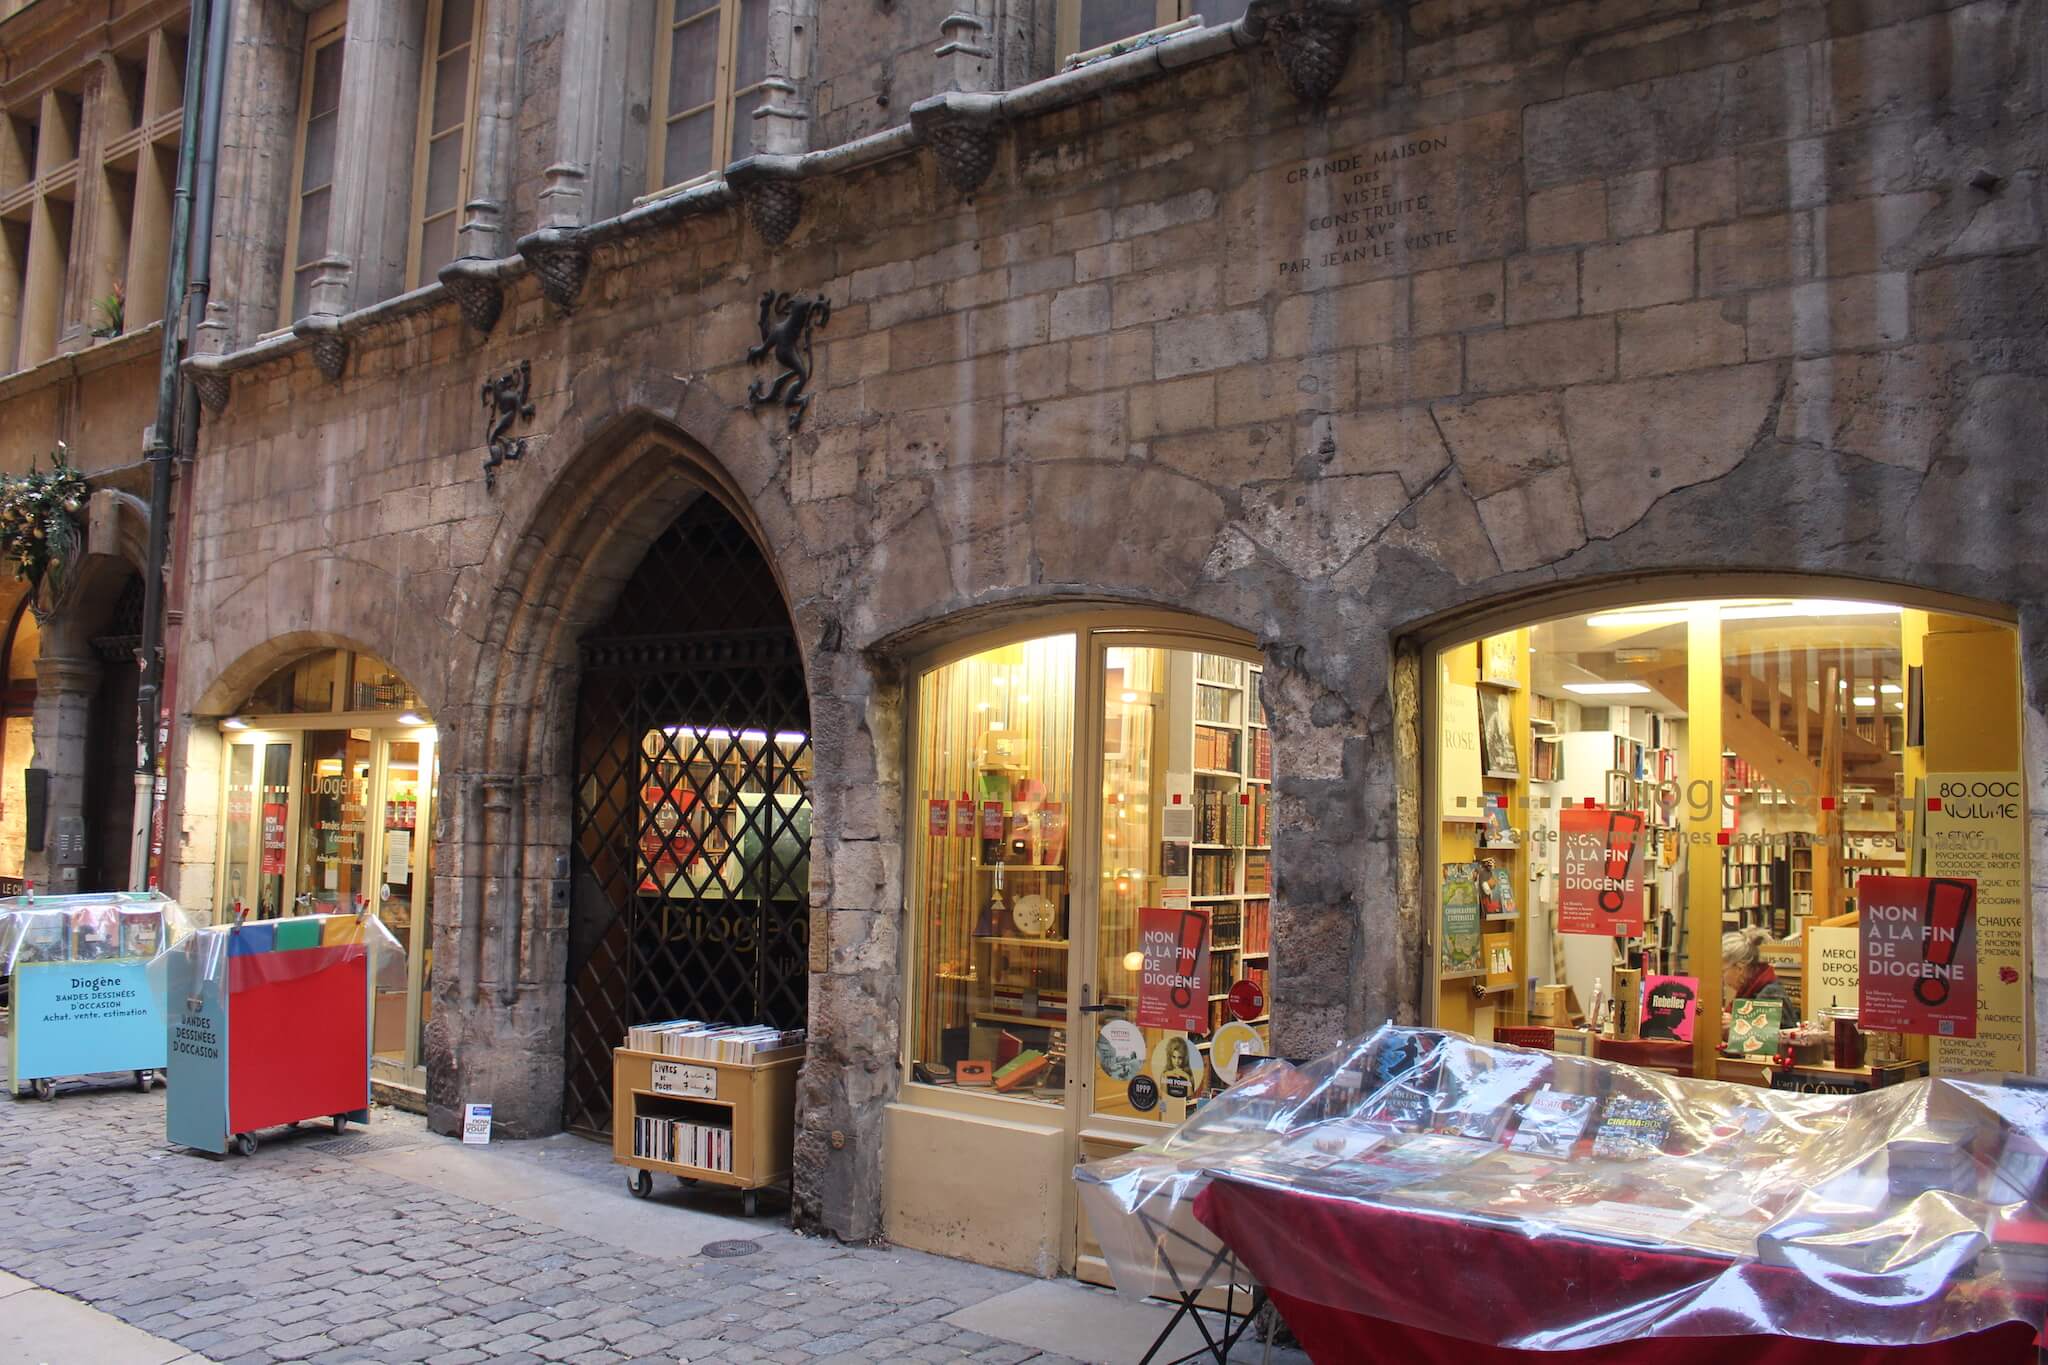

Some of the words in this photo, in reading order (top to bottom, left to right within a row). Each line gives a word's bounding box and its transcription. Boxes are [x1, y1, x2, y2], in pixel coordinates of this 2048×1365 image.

[1287, 155, 1363, 184] GRANDE
[1373, 136, 1449, 165] MAISON
[1353, 171, 1380, 186] DES
[1343, 184, 1392, 206] VISTE
[1309, 195, 1428, 232] CONSTRUITE
[1336, 229, 1358, 247] AU
[1279, 258, 1311, 276] PAR
[1373, 241, 1395, 258] LE
[1403, 230, 1457, 250] VISTE
[1445, 729, 1474, 751] ROSE
[311, 772, 356, 800] Diogè
[1609, 826, 1711, 845] modernes
[1566, 846, 1575, 860] À
[1580, 848, 1599, 861] LA
[1604, 848, 1629, 862] FIN
[1566, 863, 1585, 875] DE
[3, 883, 12, 894] LE
[1566, 876, 1635, 892] DIOGÈNE
[1869, 905, 1918, 921] NON
[1144, 931, 1174, 944] NON
[1868, 920, 1882, 938] À
[1888, 924, 1914, 940] LA
[1921, 926, 1955, 942] FIN
[1156, 947, 1172, 958] LA
[1175, 946, 1197, 961] FIN
[1822, 948, 1856, 959] MERCI
[1869, 941, 1896, 958] DE
[1144, 958, 1160, 972] DE
[1822, 962, 1858, 973] DEPOS
[1869, 959, 1965, 980] DIOGÈNE
[71, 976, 122, 991] Diogène
[1144, 970, 1201, 989] DIOGÈNE
[1822, 976, 1845, 986] VOS
[56, 992, 89, 1002] BANDES
[91, 990, 136, 1000] DESSINÉES
[1652, 994, 1685, 1010] Rebelles
[71, 1001, 121, 1011] D'OCCASION
[103, 1008, 148, 1018] estimation
[176, 1027, 216, 1045] DESSINÉES
[173, 1040, 218, 1059] D'OCCASION
[655, 1063, 677, 1074] LIVRES
[1776, 1080, 1793, 1089] L'art
